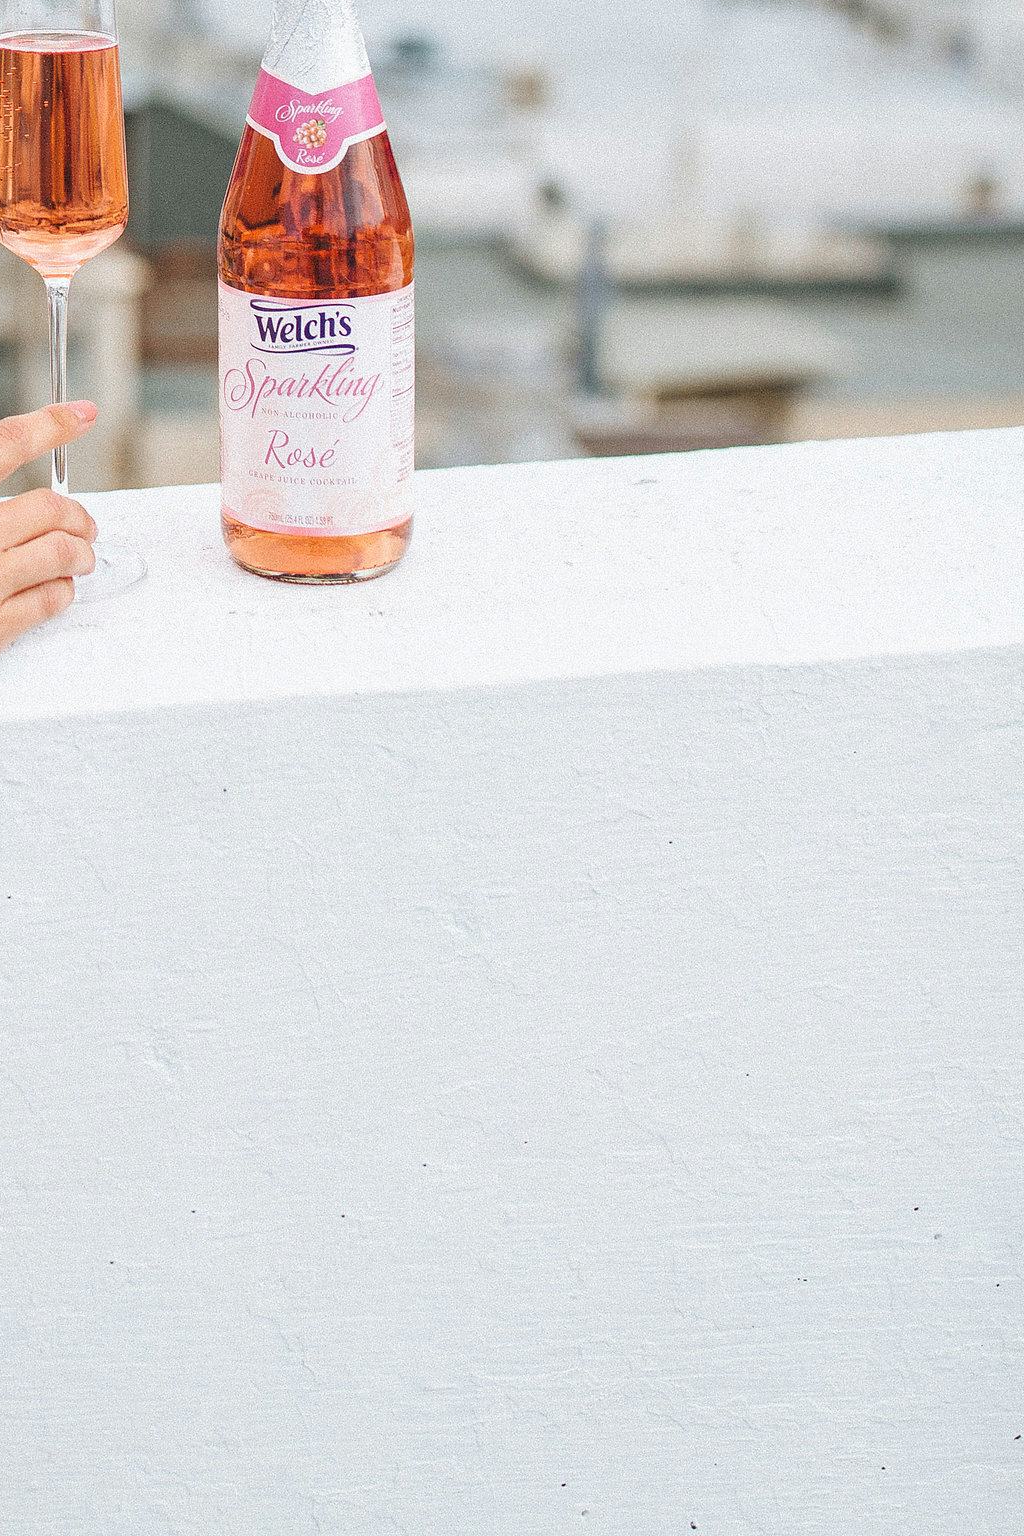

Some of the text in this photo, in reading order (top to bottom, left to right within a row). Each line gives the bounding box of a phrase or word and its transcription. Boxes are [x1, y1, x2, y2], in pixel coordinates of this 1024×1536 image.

[275, 98, 345, 123] Sparkling
[296, 148, 326, 164] Rosé
[253, 311, 352, 344] Welch's
[224, 356, 385, 424] Sparkling
[264, 429, 340, 469] Rosé
[248, 470, 357, 486] GRAPE JUICE COCKTAIL
